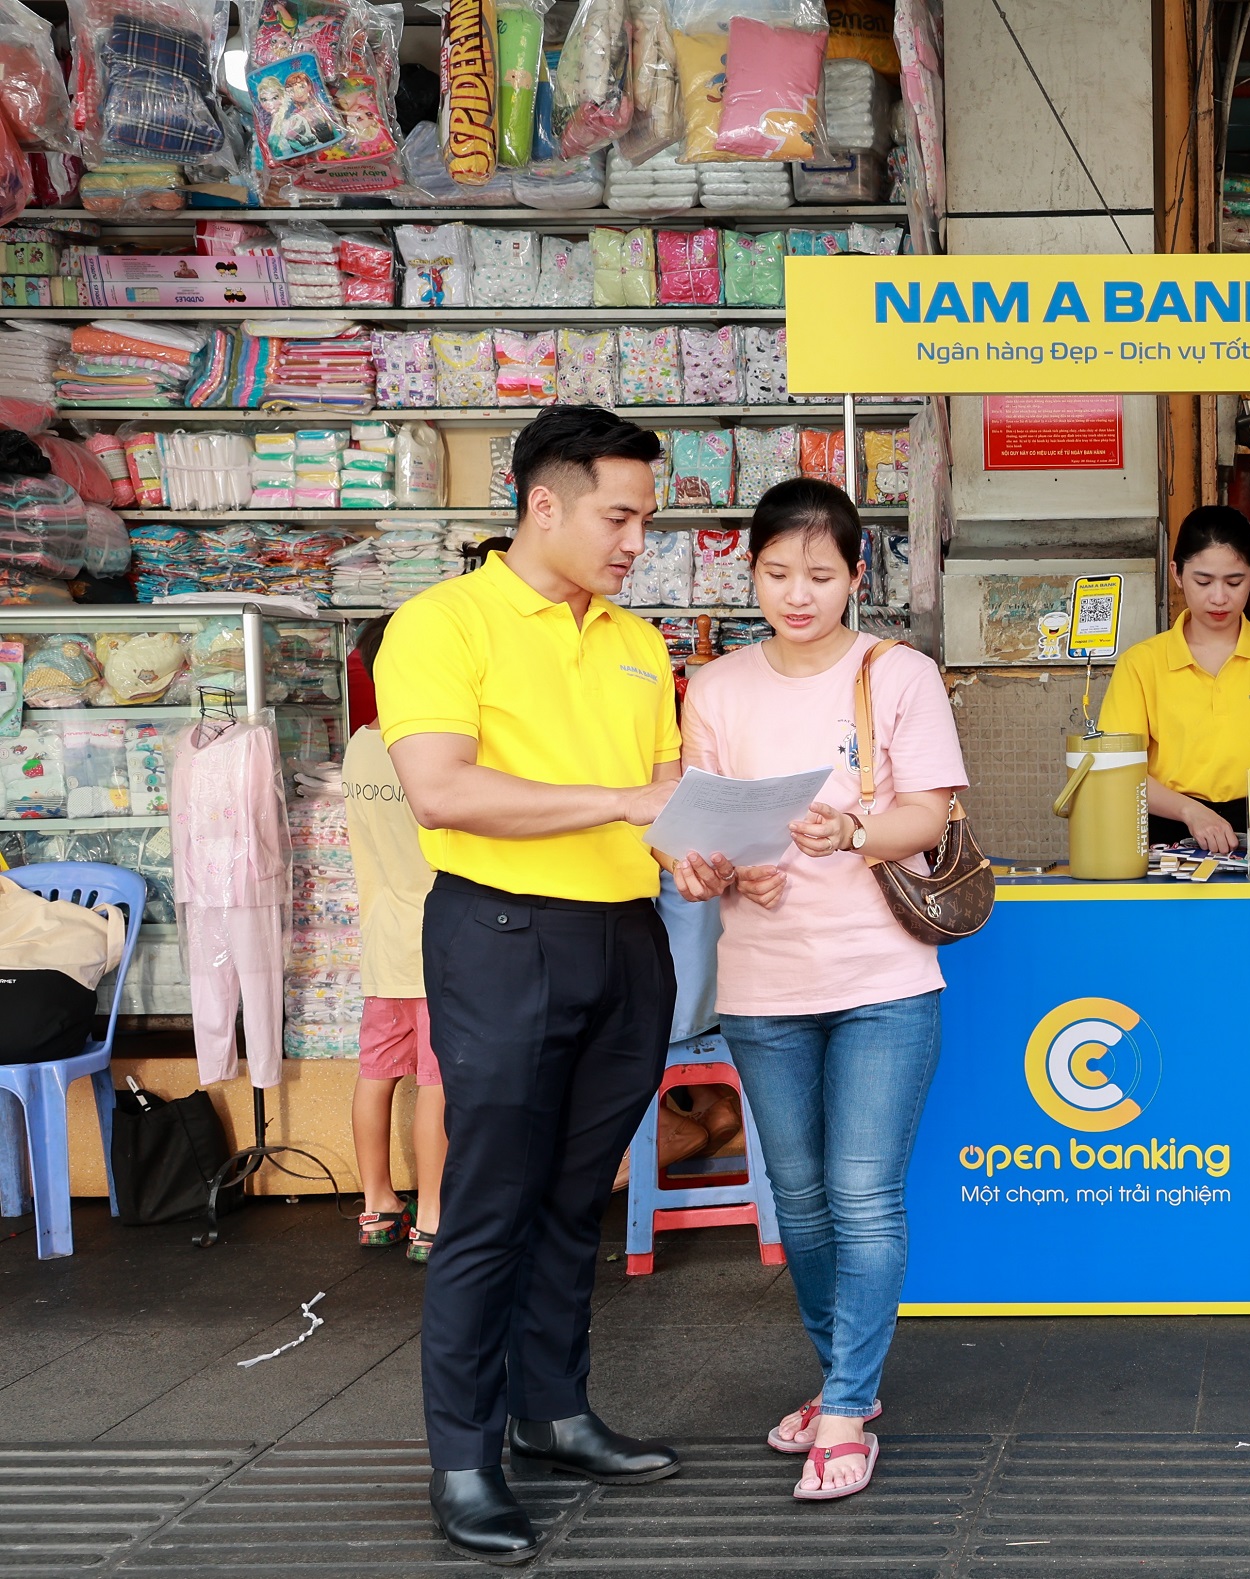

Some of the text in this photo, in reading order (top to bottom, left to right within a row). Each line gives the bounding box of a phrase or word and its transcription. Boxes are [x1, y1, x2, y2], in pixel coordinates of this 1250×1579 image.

[440, 47, 449, 94] MARVEL
[875, 281, 1030, 323] NAM
[1042, 281, 1091, 323] A
[917, 342, 980, 364] Ngân
[986, 341, 1044, 364] hàng
[1050, 341, 1098, 364] Đẹp
[1119, 341, 1173, 364] Dịch
[1178, 345, 1206, 364] vụ
[1210, 338, 1250, 361] Tốt
[1140, 778, 1148, 857] THERMAL
[959, 1138, 1230, 1178] open banking
[961, 1183, 1231, 1206] Một chạm, mọi trải nghiệm
